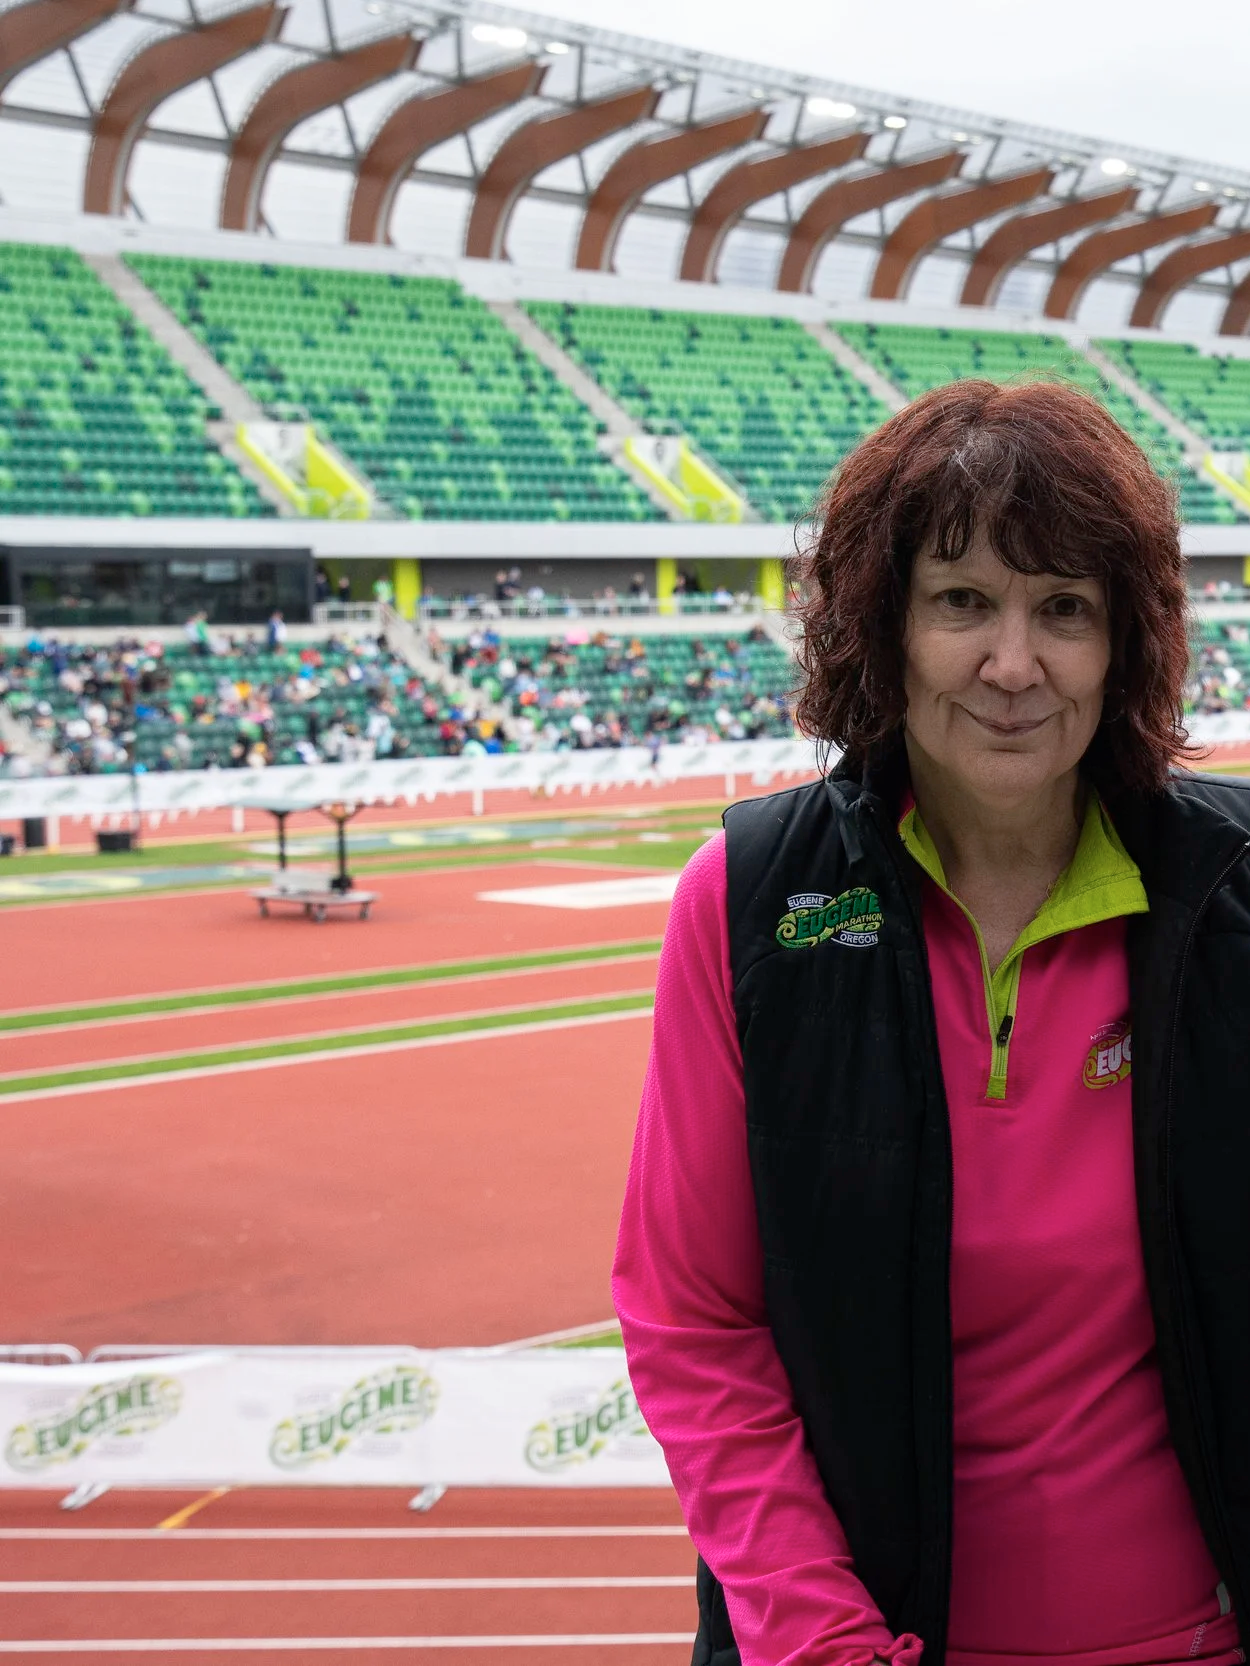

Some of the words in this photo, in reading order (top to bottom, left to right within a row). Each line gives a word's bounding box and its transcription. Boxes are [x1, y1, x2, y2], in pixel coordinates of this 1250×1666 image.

[787, 896, 824, 908] EUGENE
[796, 892, 881, 939] EUGENE
[835, 912, 883, 932] MARATHON
[839, 931, 879, 944] OREGON
[37, 1380, 155, 1454] EUGENE
[302, 1377, 416, 1452] EUGENE
[556, 1390, 639, 1454] EUGE
